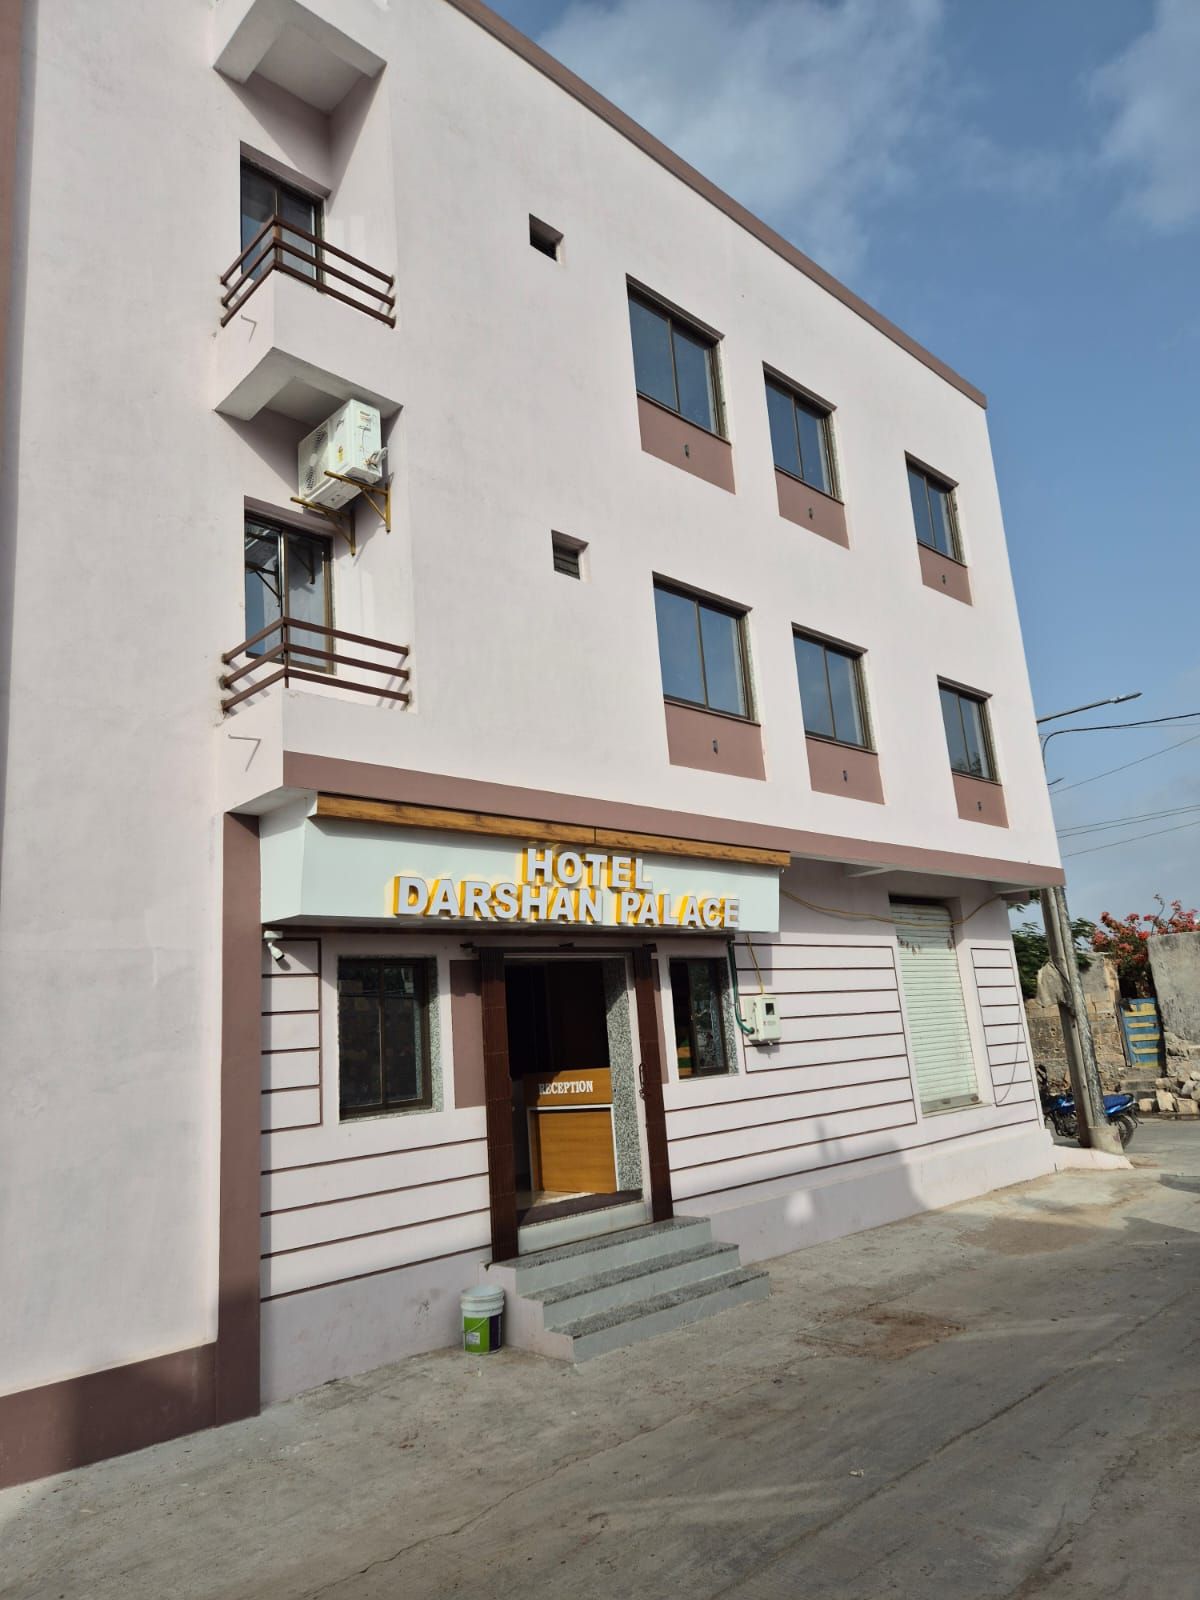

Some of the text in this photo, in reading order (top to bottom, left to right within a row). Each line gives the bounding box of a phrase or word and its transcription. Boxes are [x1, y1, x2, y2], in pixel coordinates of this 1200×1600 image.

[522, 847, 653, 890] HOTEL
[394, 876, 740, 928] DARSHAN PALACE
[538, 1080, 594, 1095] RECEPTION
